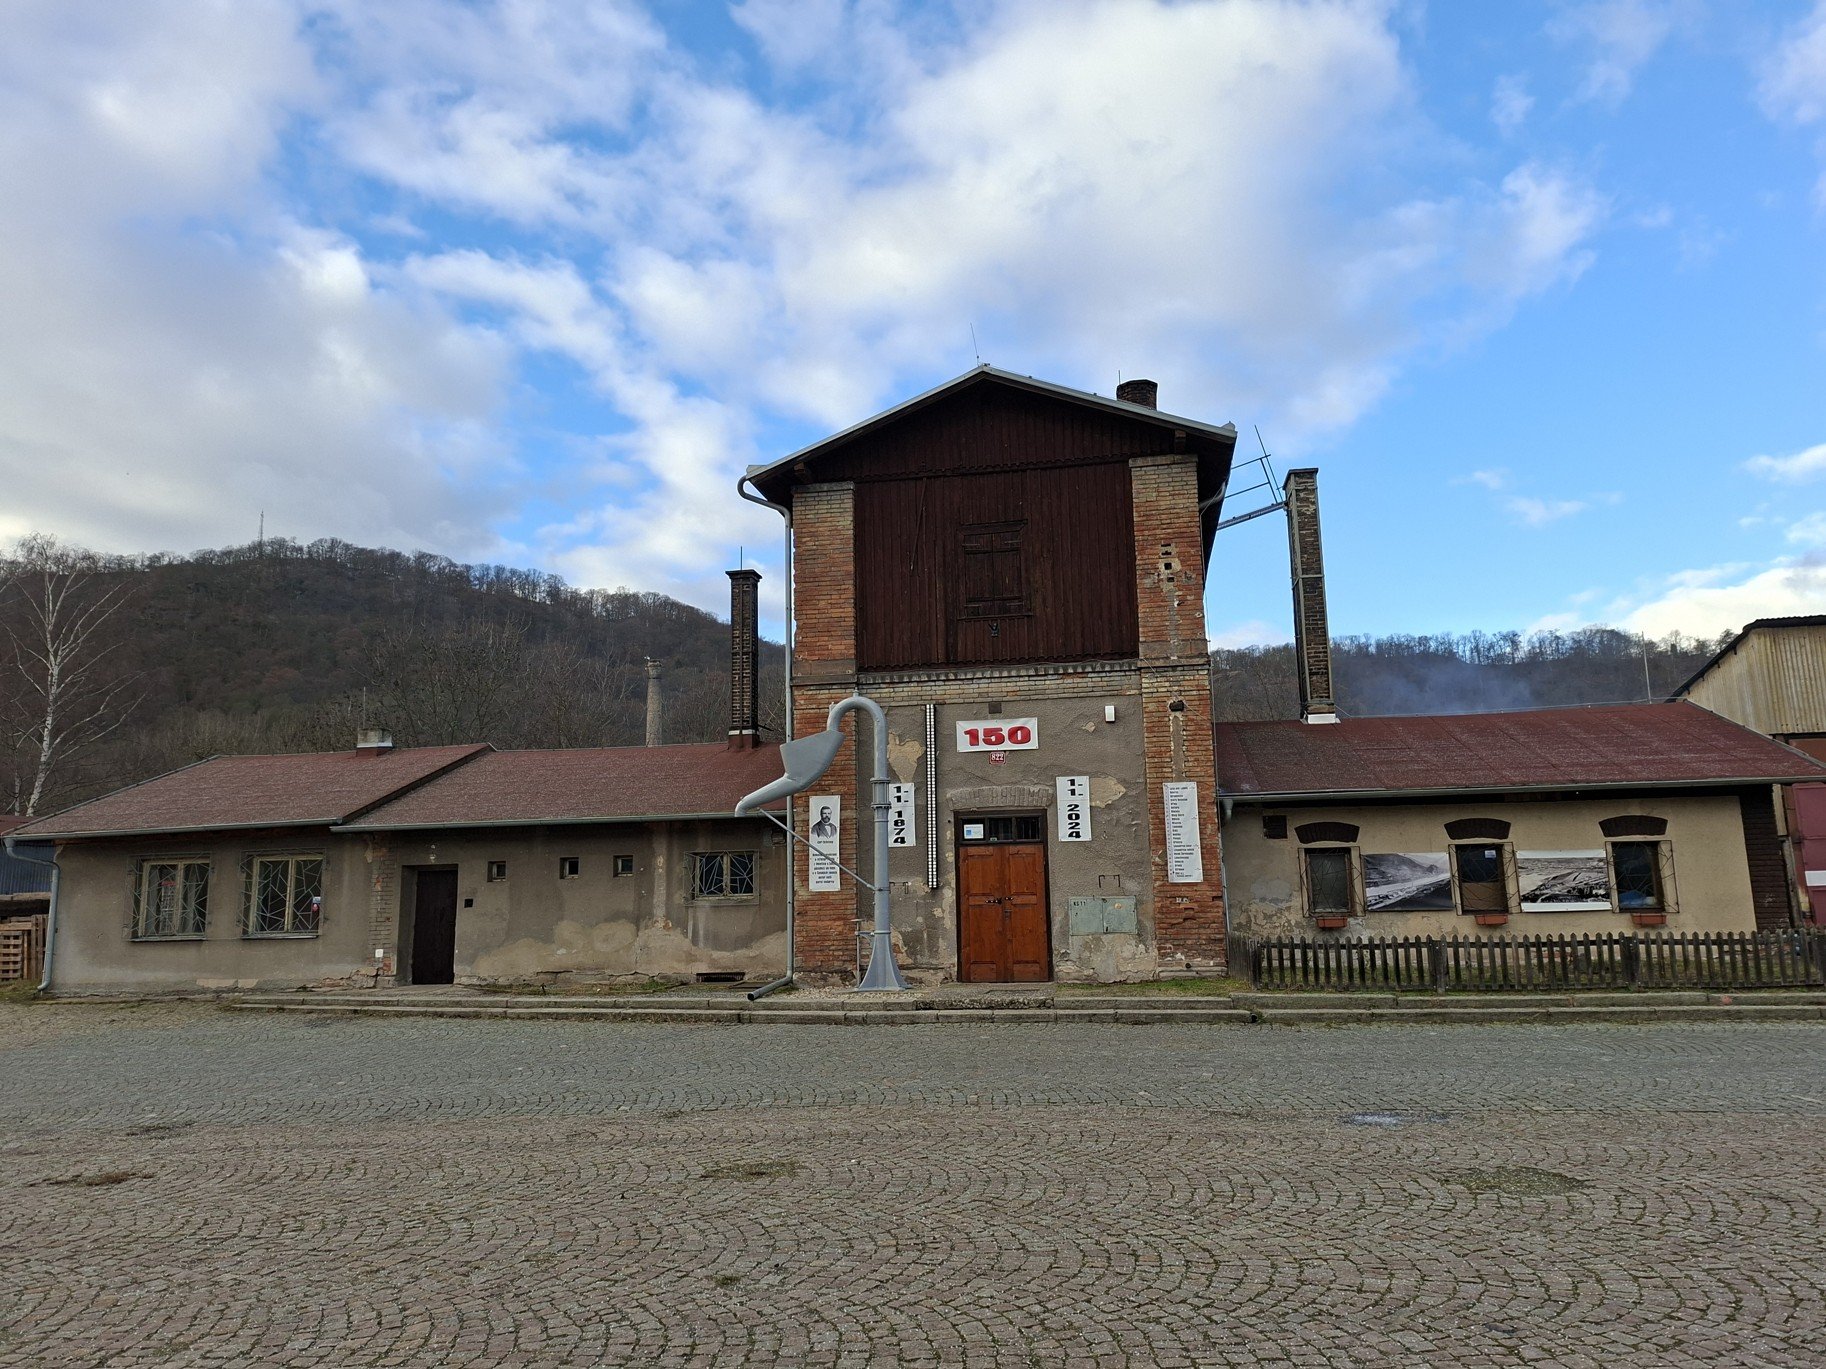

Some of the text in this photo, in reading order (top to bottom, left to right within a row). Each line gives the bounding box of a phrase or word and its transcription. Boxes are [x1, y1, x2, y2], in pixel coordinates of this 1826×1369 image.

[963, 725, 1031, 746] 150
[991, 753, 1004, 761] 822
[893, 810, 906, 844] 1874
[1067, 803, 1082, 838] 2024
